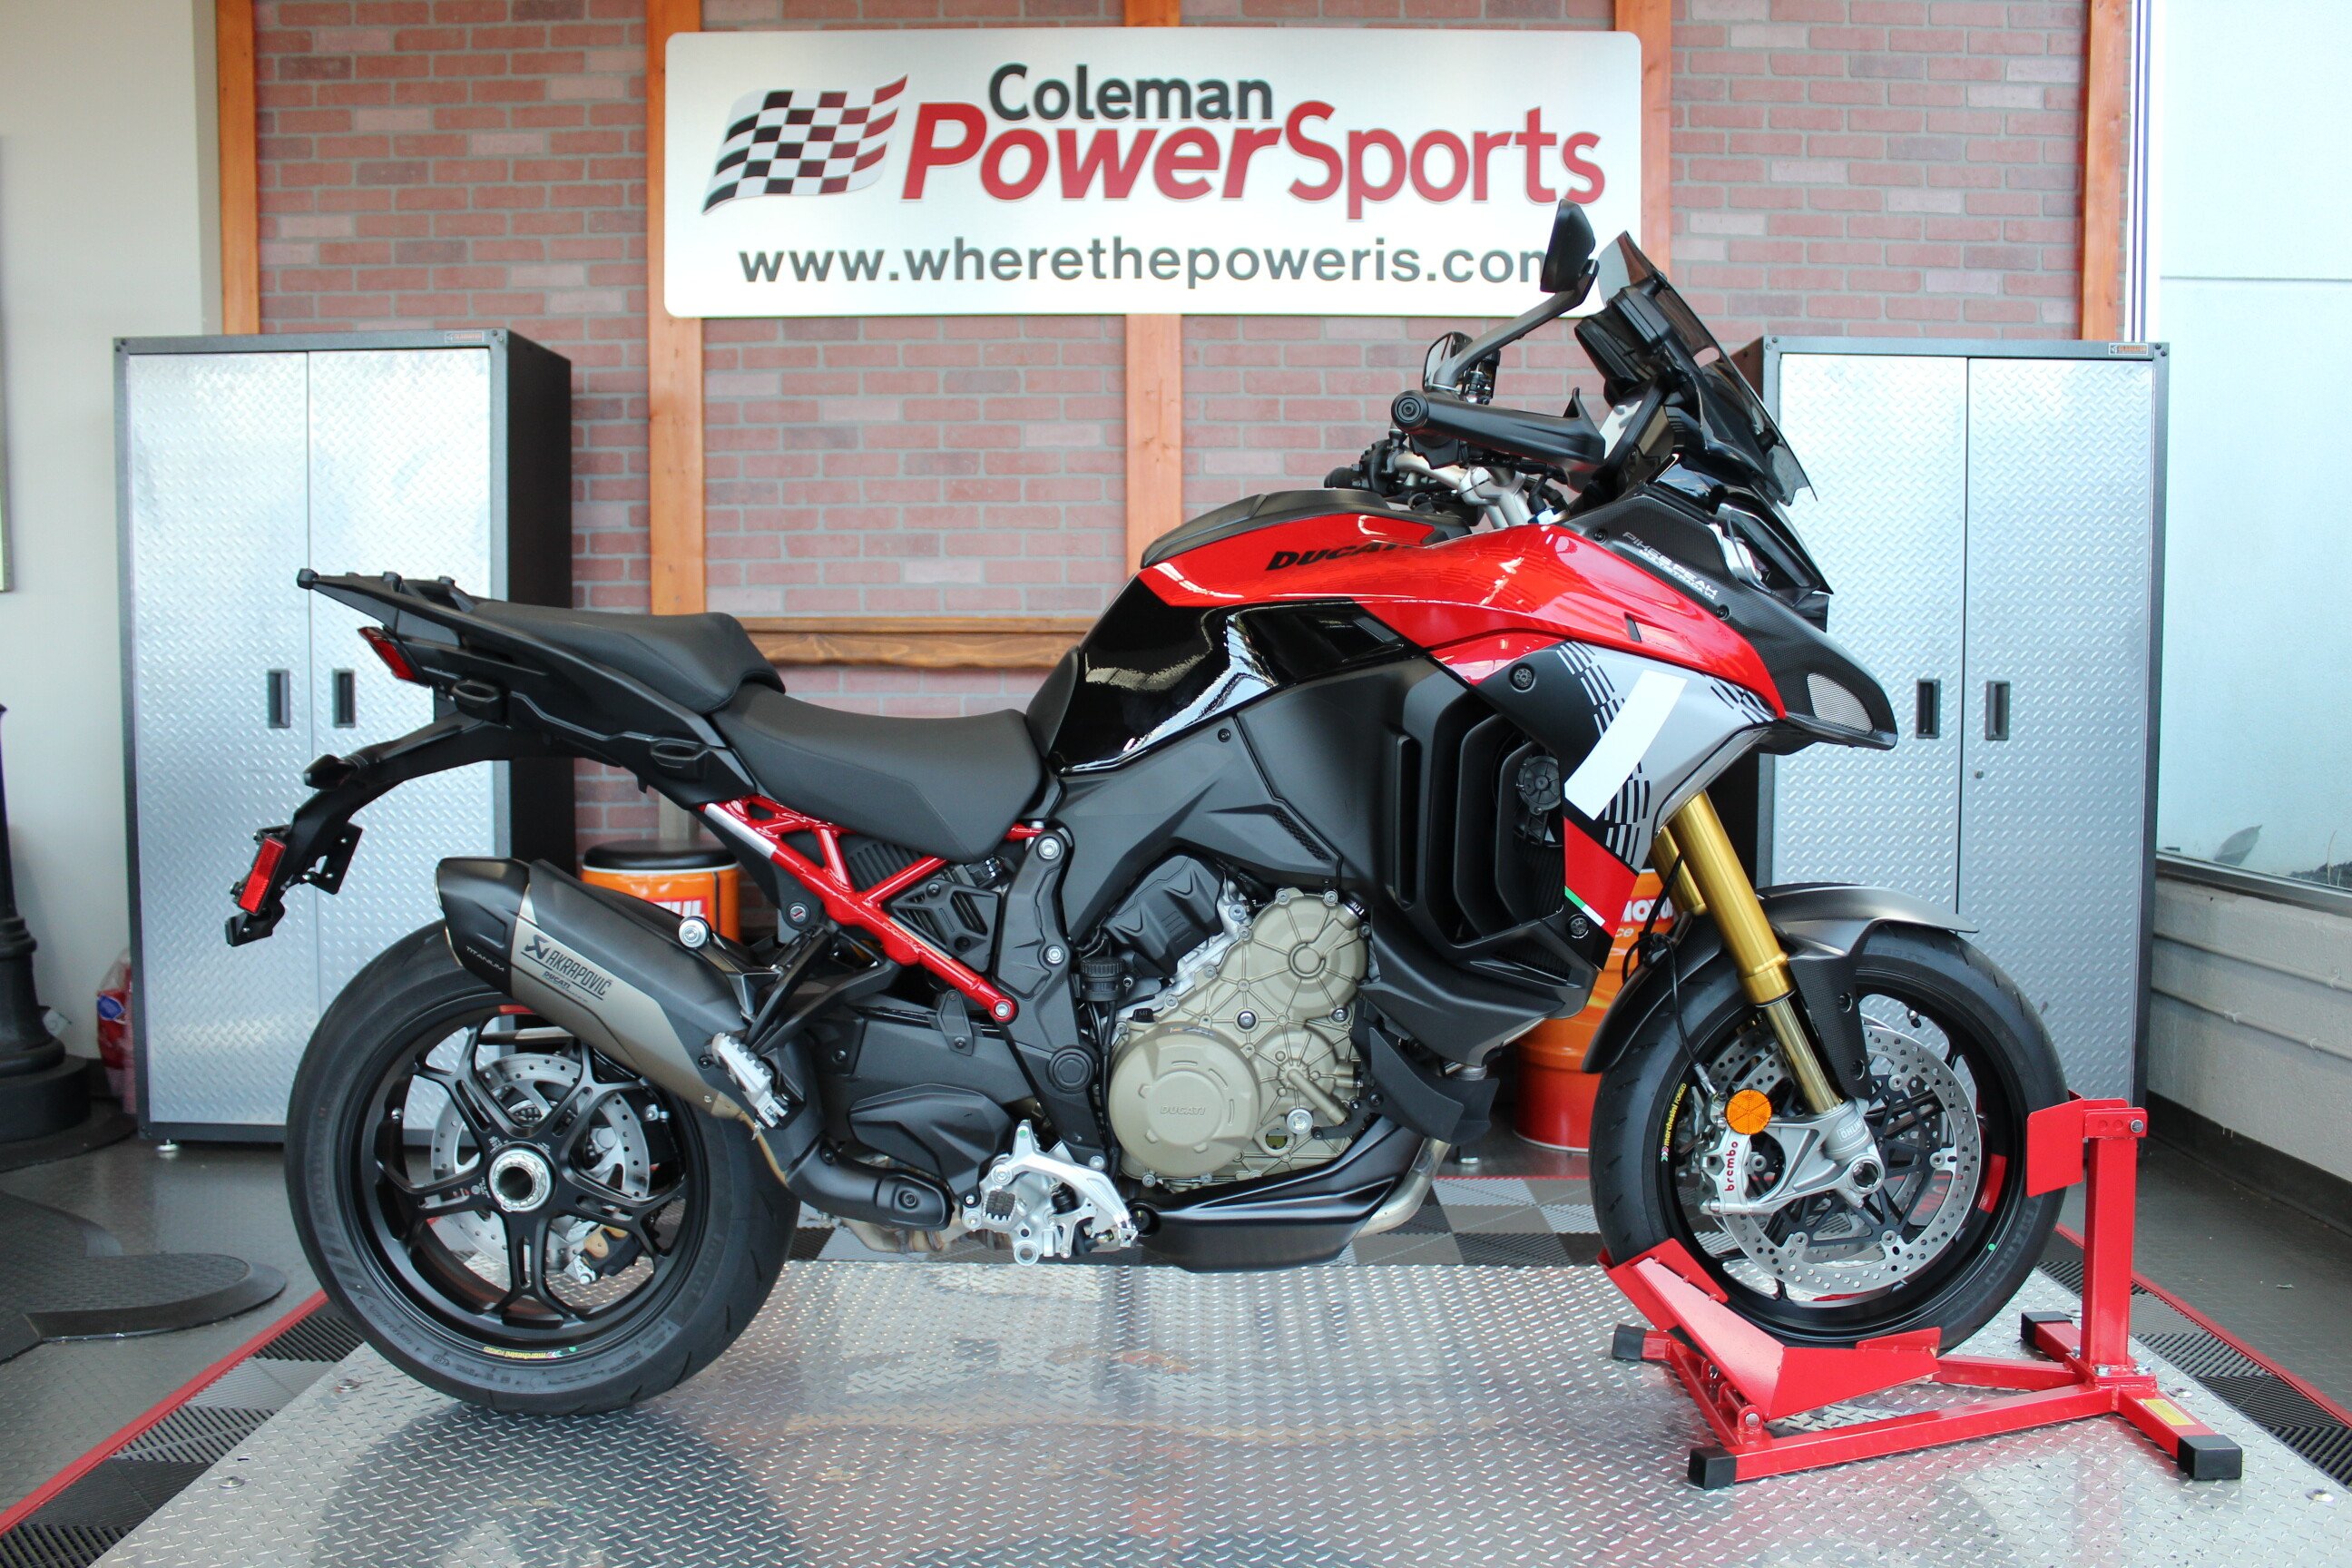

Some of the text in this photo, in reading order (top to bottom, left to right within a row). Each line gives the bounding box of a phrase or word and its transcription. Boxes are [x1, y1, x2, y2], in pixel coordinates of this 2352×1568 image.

[988, 64, 1273, 122] Coleman
[902, 100, 1605, 218] PowerSports
[1265, 541, 1412, 572] DUCA
[1622, 531, 1719, 596] PIKES PEAK
[466, 946, 505, 973] TITANIUM
[544, 970, 572, 990] DUCATI
[1160, 1104, 1207, 1116] DUCATI
[1663, 1102, 1680, 1147] marchesini
[1723, 1141, 1739, 1192] brembo
